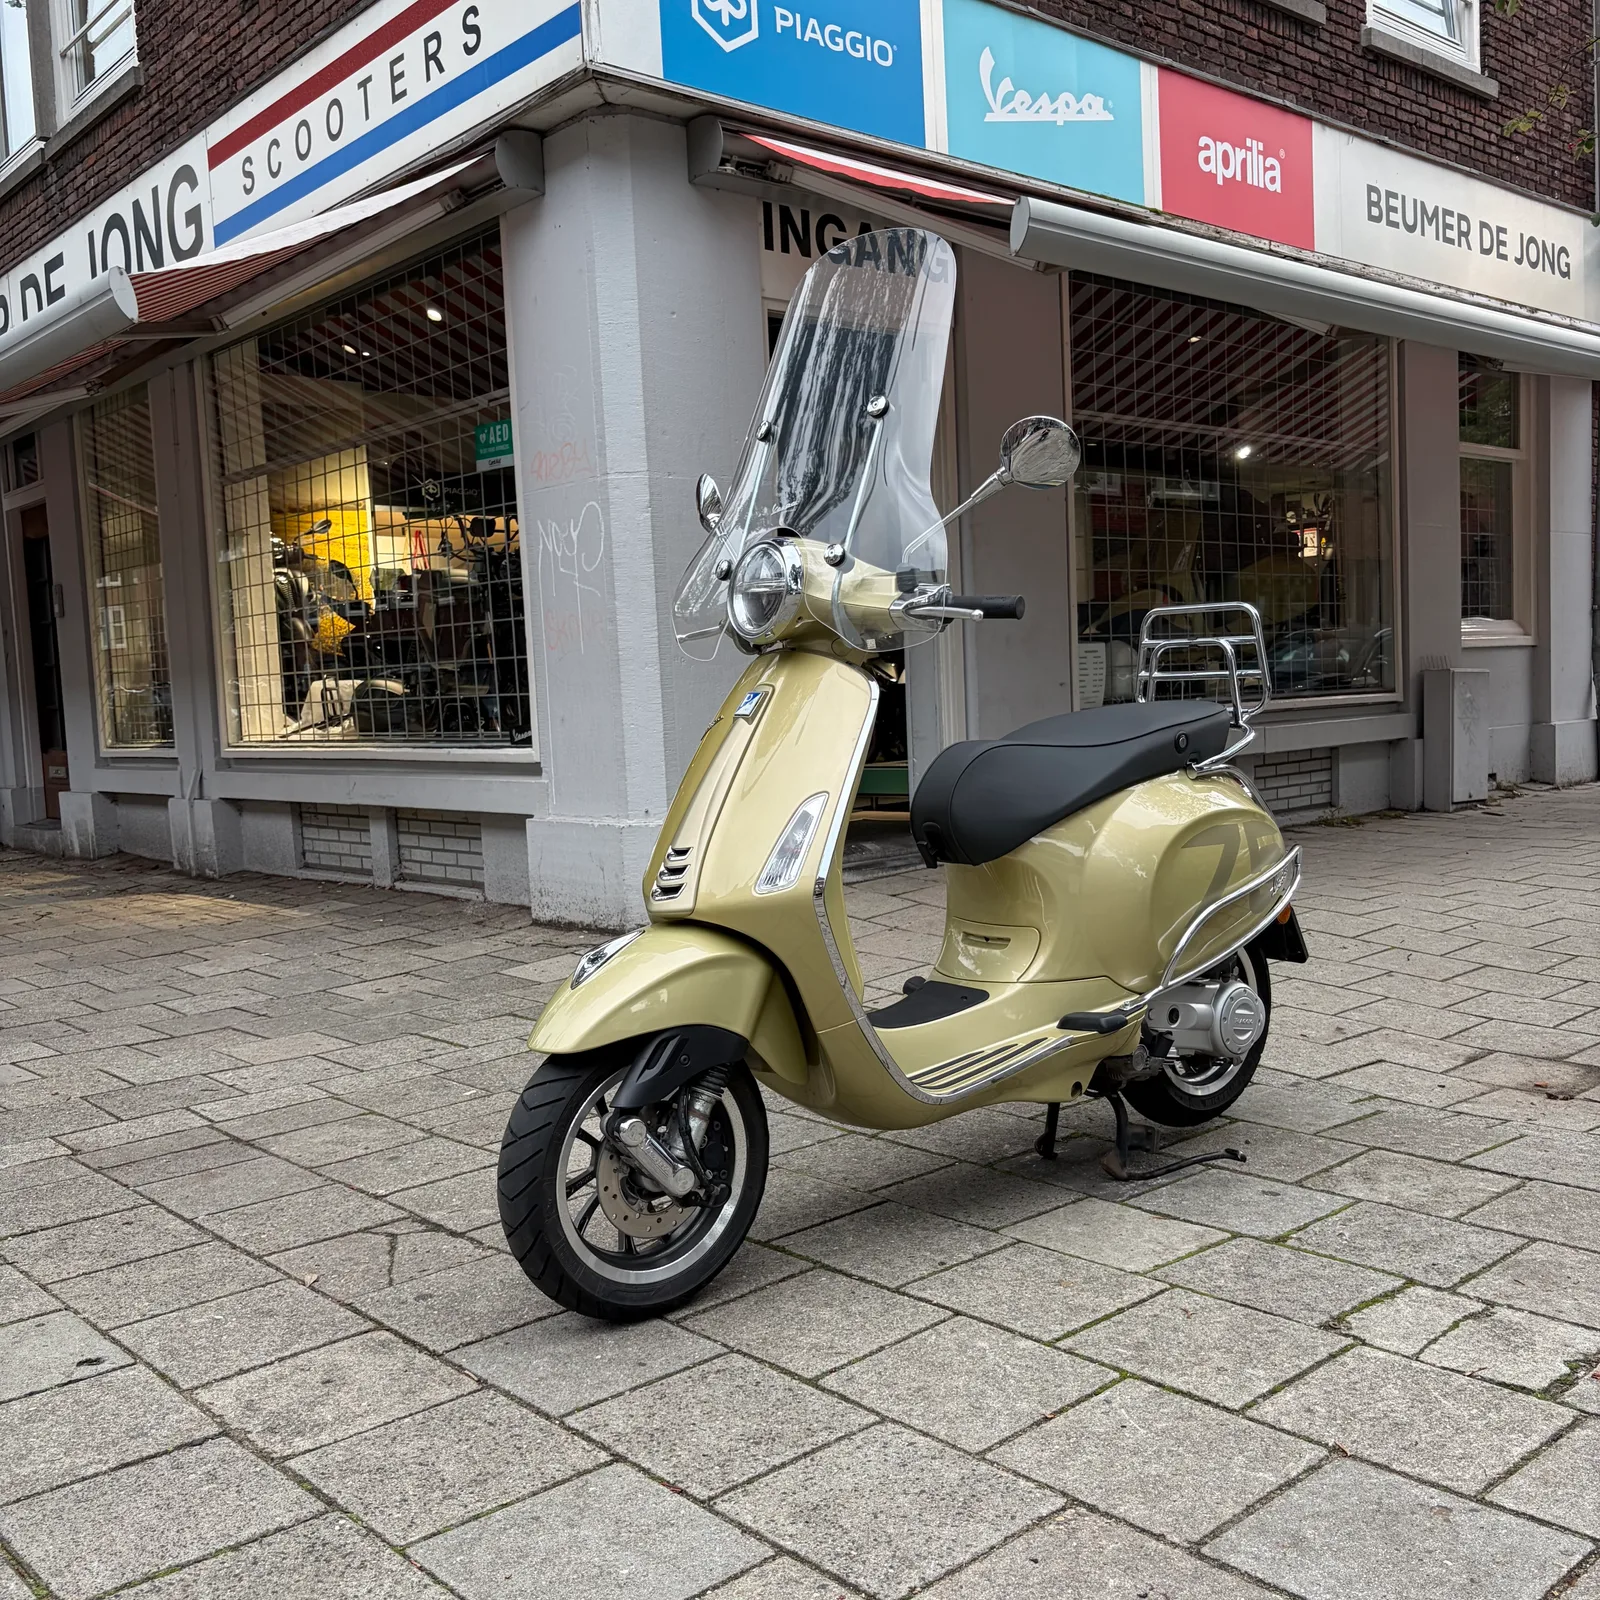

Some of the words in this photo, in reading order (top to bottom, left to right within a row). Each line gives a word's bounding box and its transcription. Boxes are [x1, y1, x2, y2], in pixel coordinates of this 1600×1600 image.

[774, 6, 893, 67] PIAGGIO
[242, 5, 481, 195] SCOOTERS
[979, 46, 1114, 125] Vespa
[1198, 136, 1282, 193] aprilia
[763, 201, 949, 284] INGANG
[1366, 183, 1472, 251] BEUMER
[1479, 220, 1508, 262] DE
[1514, 232, 1571, 280] JONG
[489, 424, 509, 444] AED
